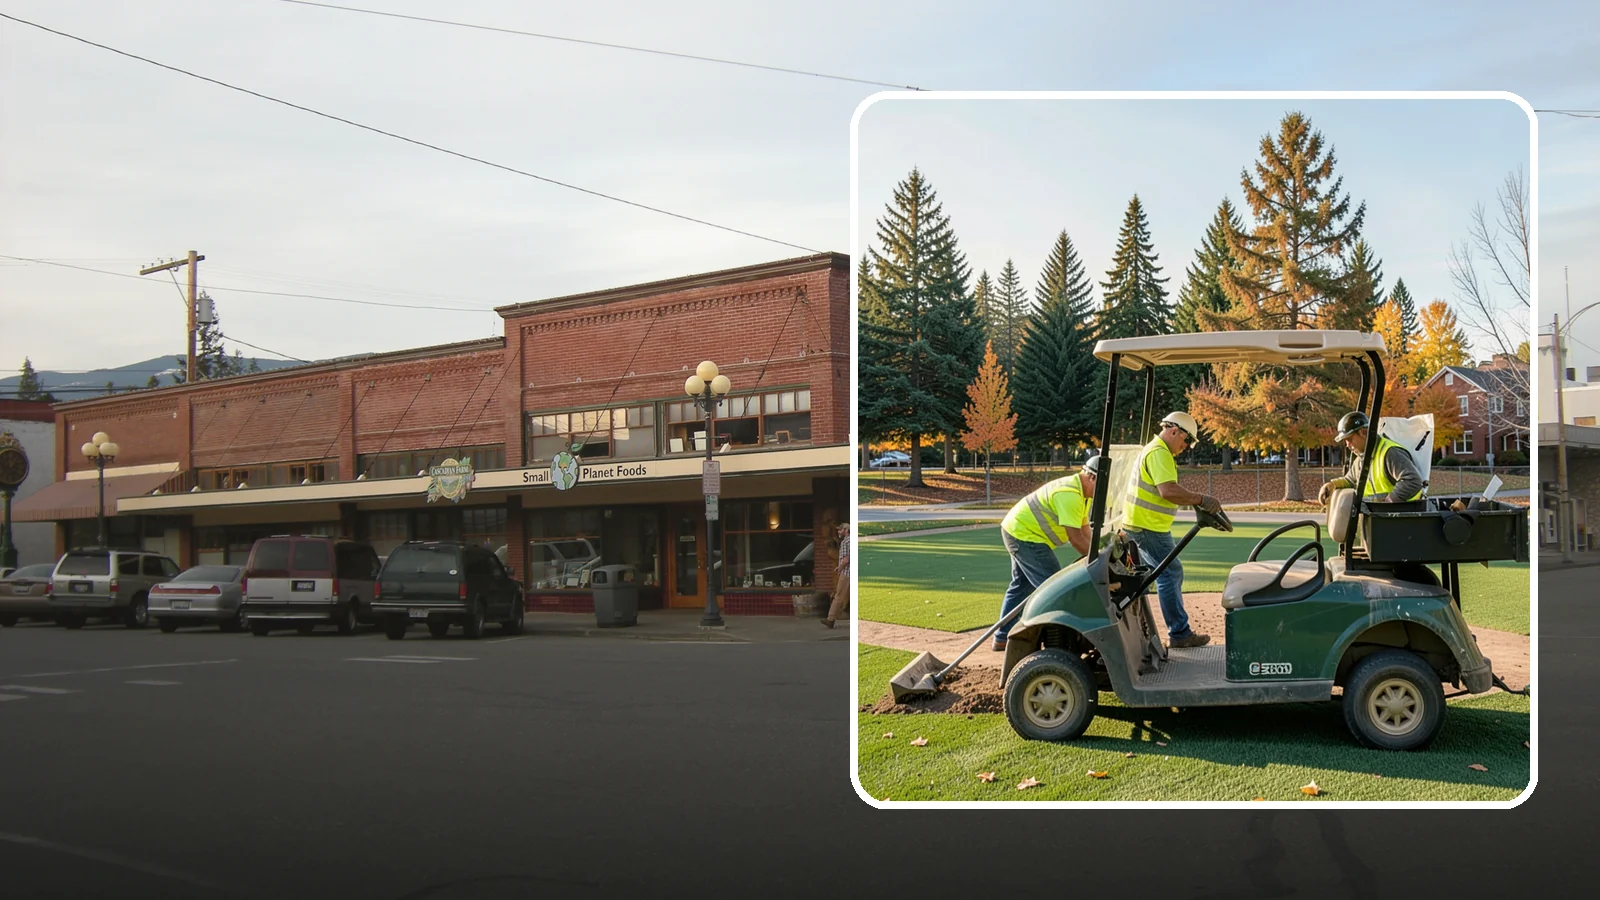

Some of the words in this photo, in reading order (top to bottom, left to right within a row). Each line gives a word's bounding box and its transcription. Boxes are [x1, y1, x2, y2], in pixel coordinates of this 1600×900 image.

[523, 471, 549, 483] Small
[583, 468, 614, 479] Planet
[617, 464, 647, 477] Foods
